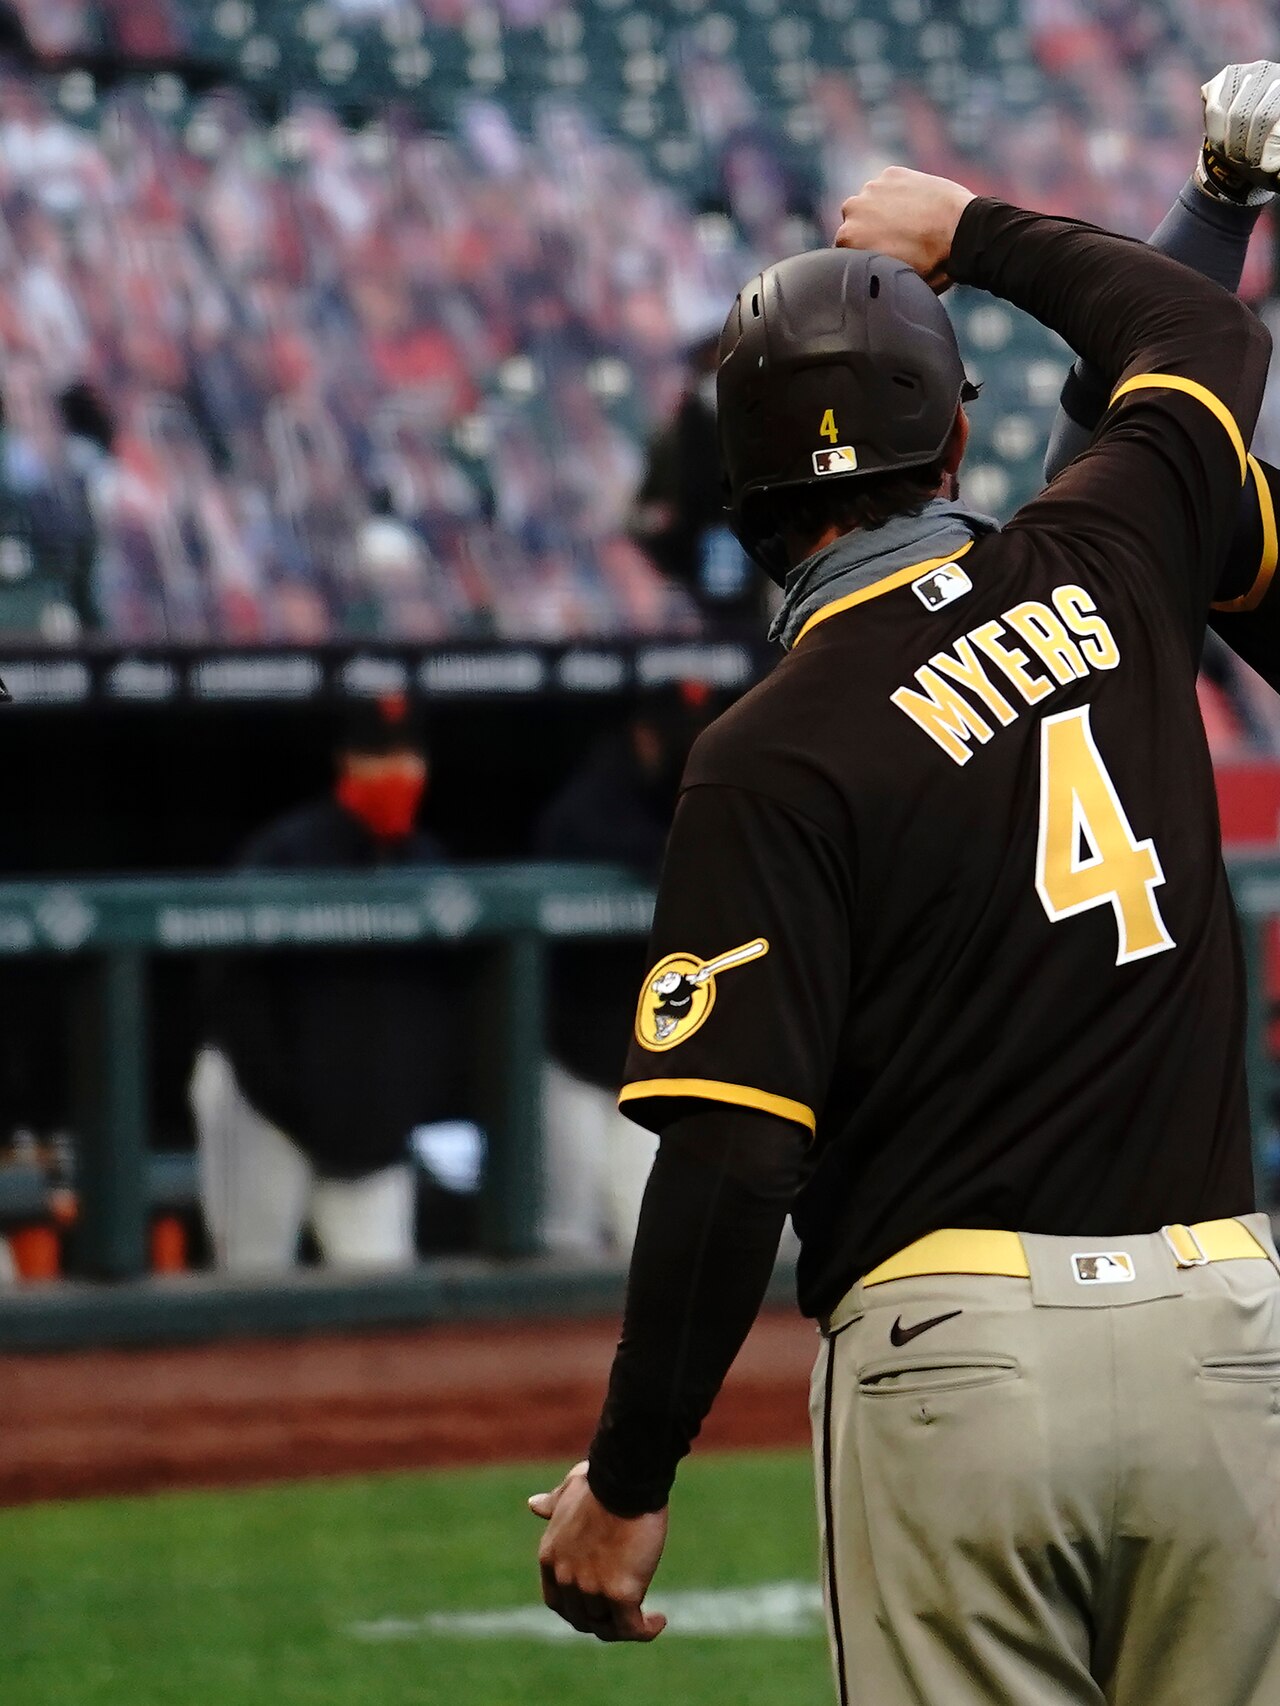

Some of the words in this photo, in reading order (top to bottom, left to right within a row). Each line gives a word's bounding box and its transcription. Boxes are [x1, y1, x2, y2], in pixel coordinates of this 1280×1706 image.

[819, 408, 839, 444] 4
[889, 584, 1121, 767] MYERS
[1034, 703, 1177, 967] 4
